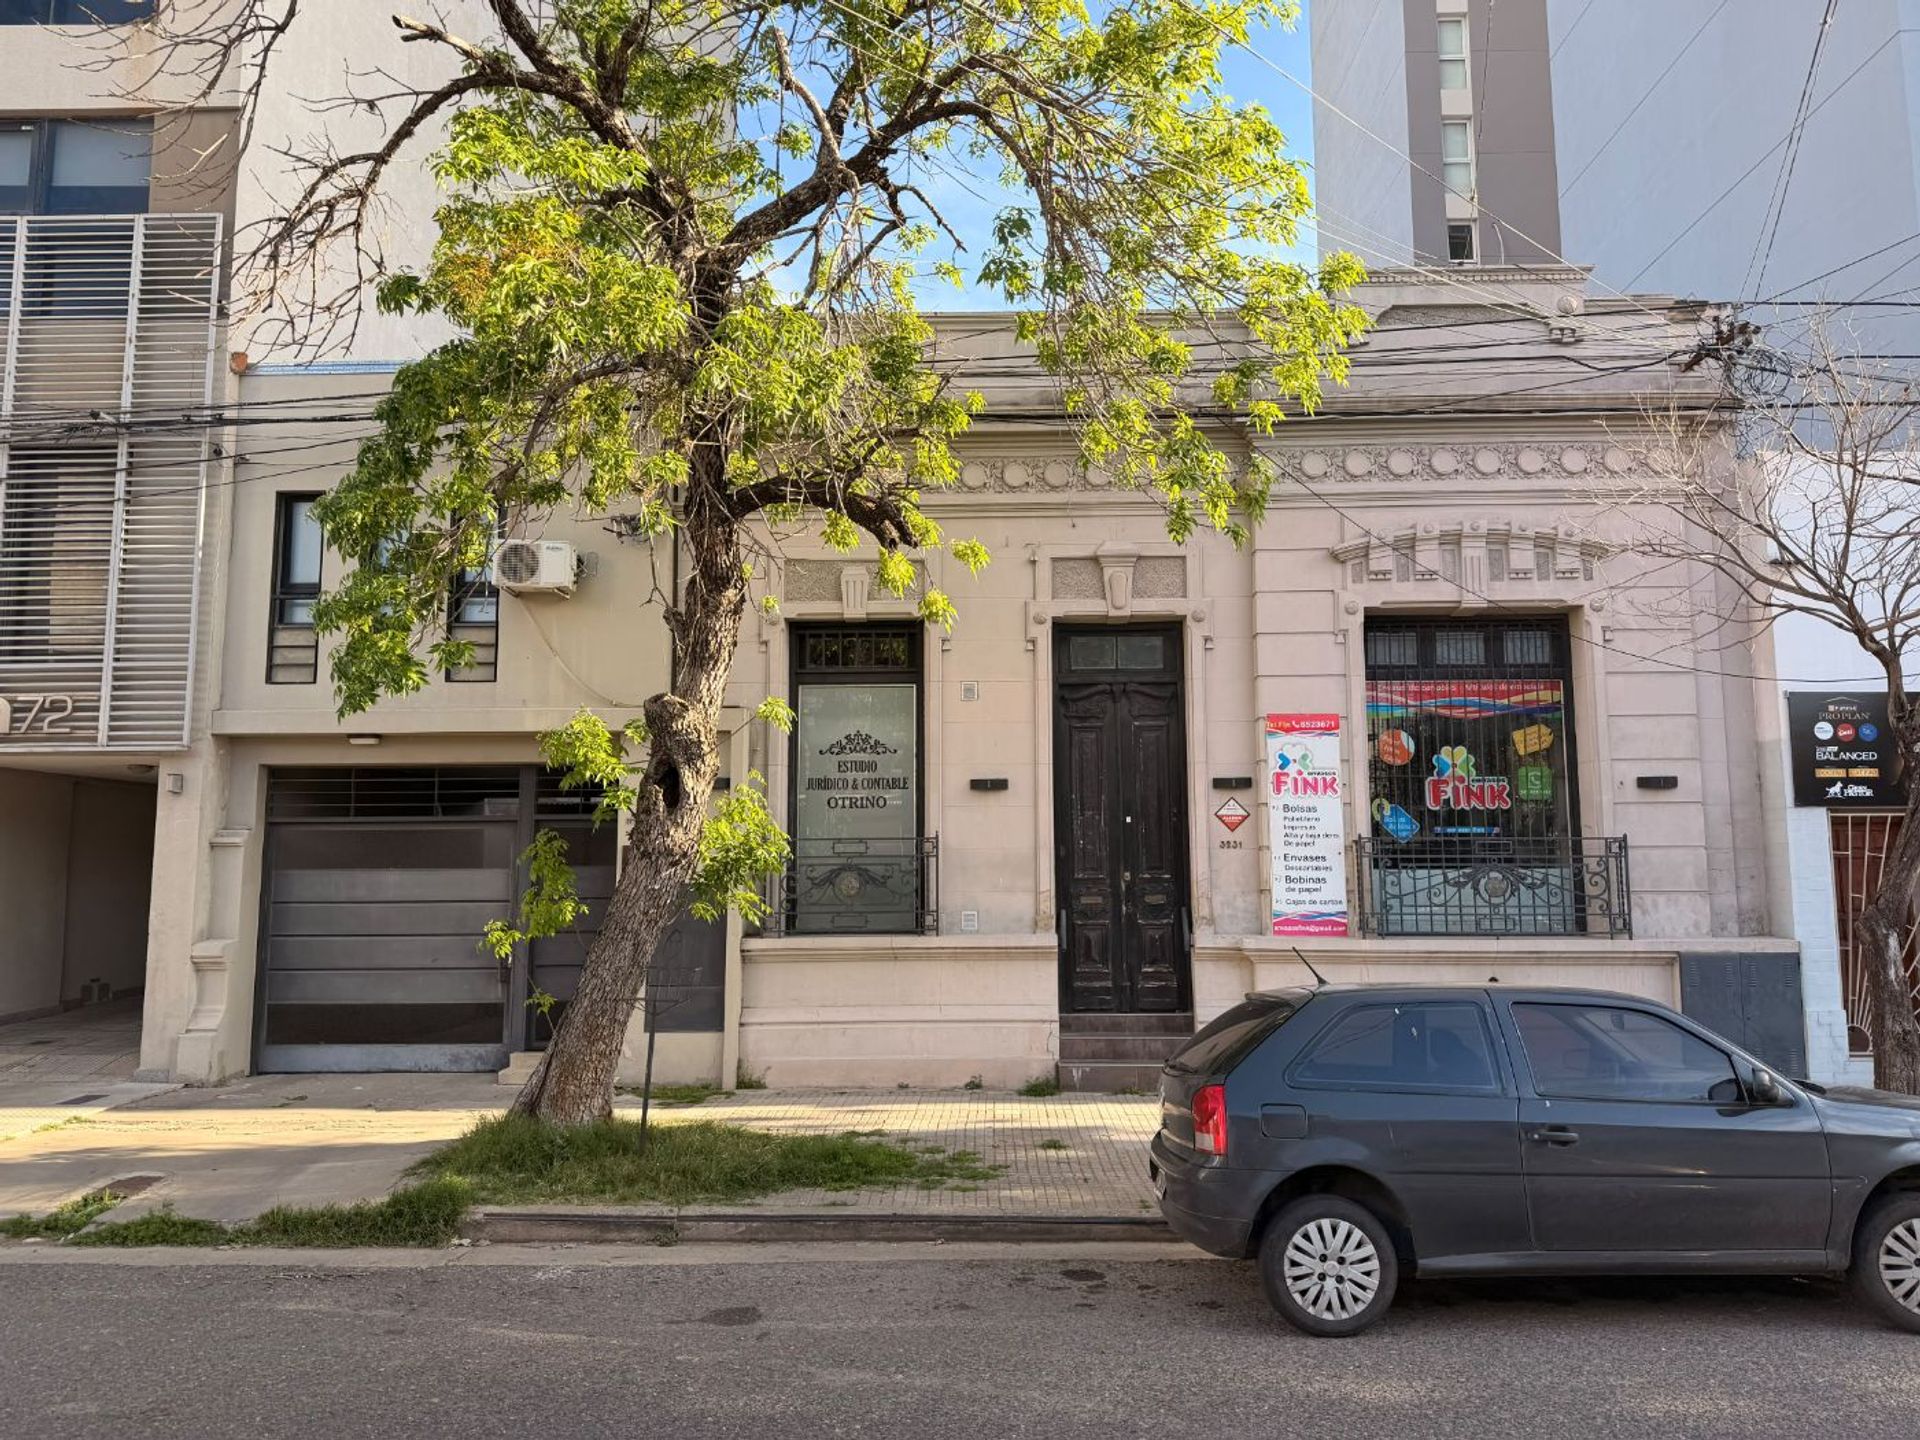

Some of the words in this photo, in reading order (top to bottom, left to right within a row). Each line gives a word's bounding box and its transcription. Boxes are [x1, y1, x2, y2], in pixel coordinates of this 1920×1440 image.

[0, 695, 73, 734] 72
[1815, 751, 1878, 760] BALANCED
[837, 760, 878, 773] ESTUDIO
[806, 776, 849, 791] JURÍDICO
[851, 780, 859, 790] &
[861, 777, 909, 790] CONTABLE
[827, 796, 887, 809] OTRINO
[1283, 803, 1318, 813] Bolsas
[1283, 853, 1327, 862] Envases
[1285, 875, 1327, 884] Bobinas
[1298, 886, 1322, 894] papel
